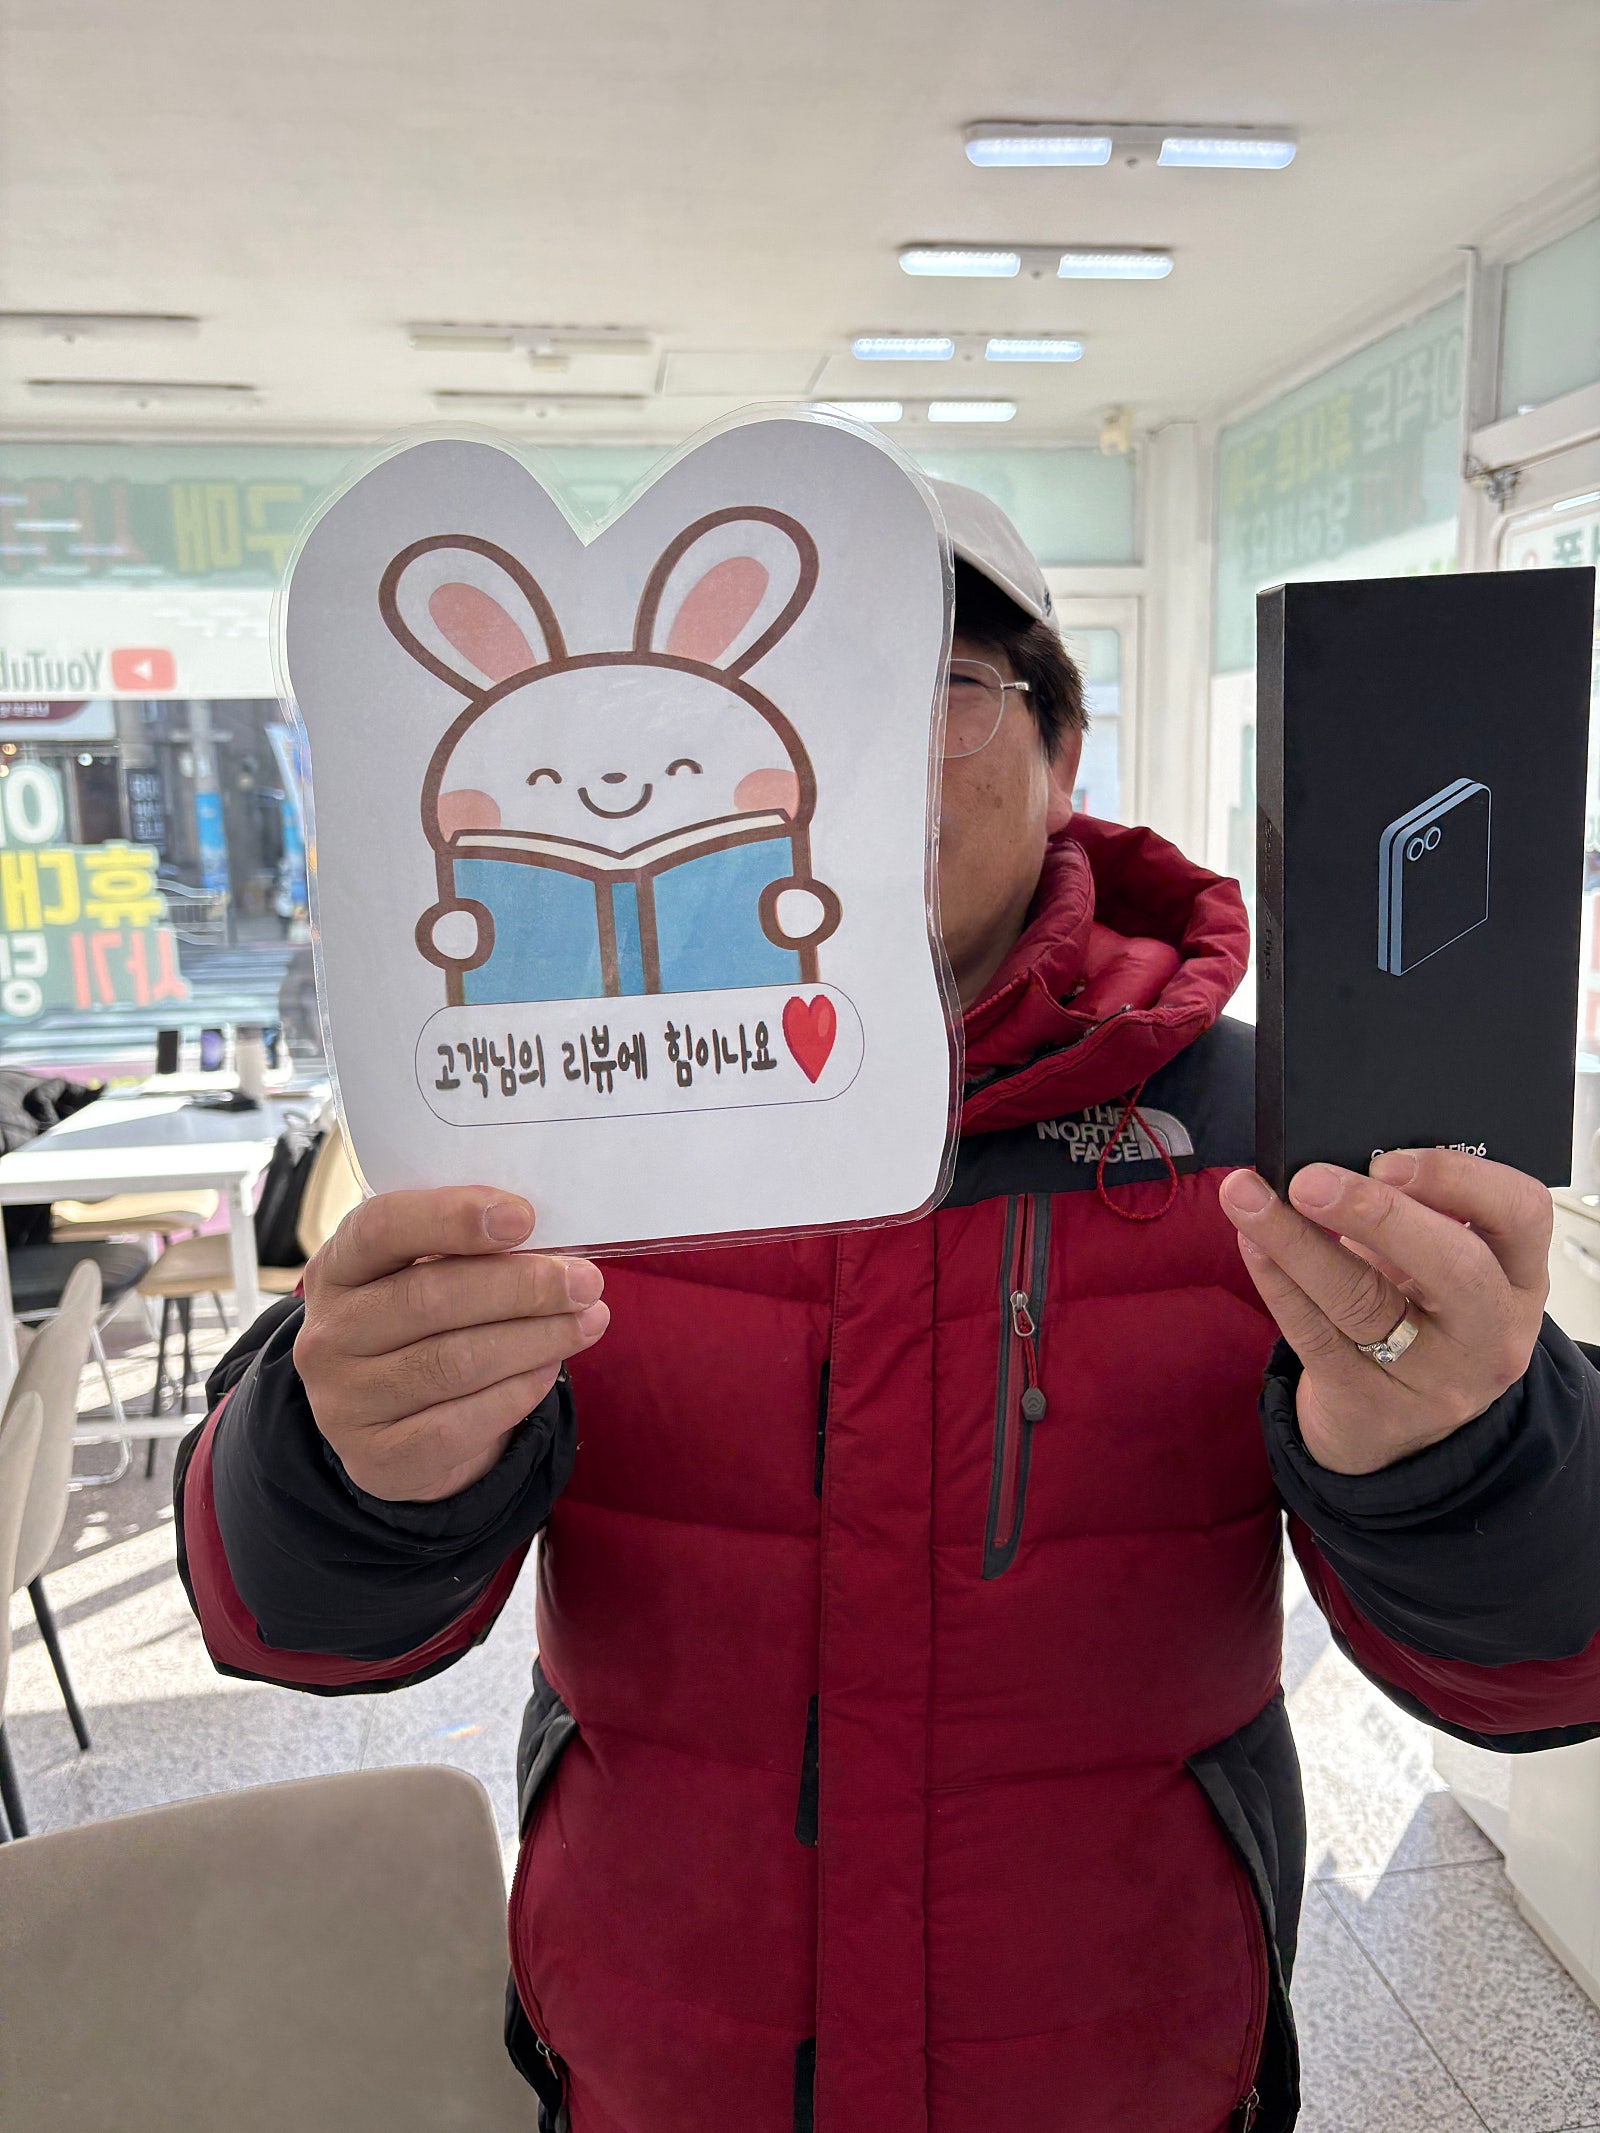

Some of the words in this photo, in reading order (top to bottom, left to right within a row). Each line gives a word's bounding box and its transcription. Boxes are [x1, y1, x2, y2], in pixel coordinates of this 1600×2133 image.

[435, 1032, 546, 1098] 고객님의
[562, 1024, 648, 1094] 리뷰에
[664, 1020, 777, 1087] 힘이나요
[1083, 1105, 1131, 1124] THE
[1037, 1121, 1136, 1144] NORTH
[1070, 1141, 1142, 1164] FACE
